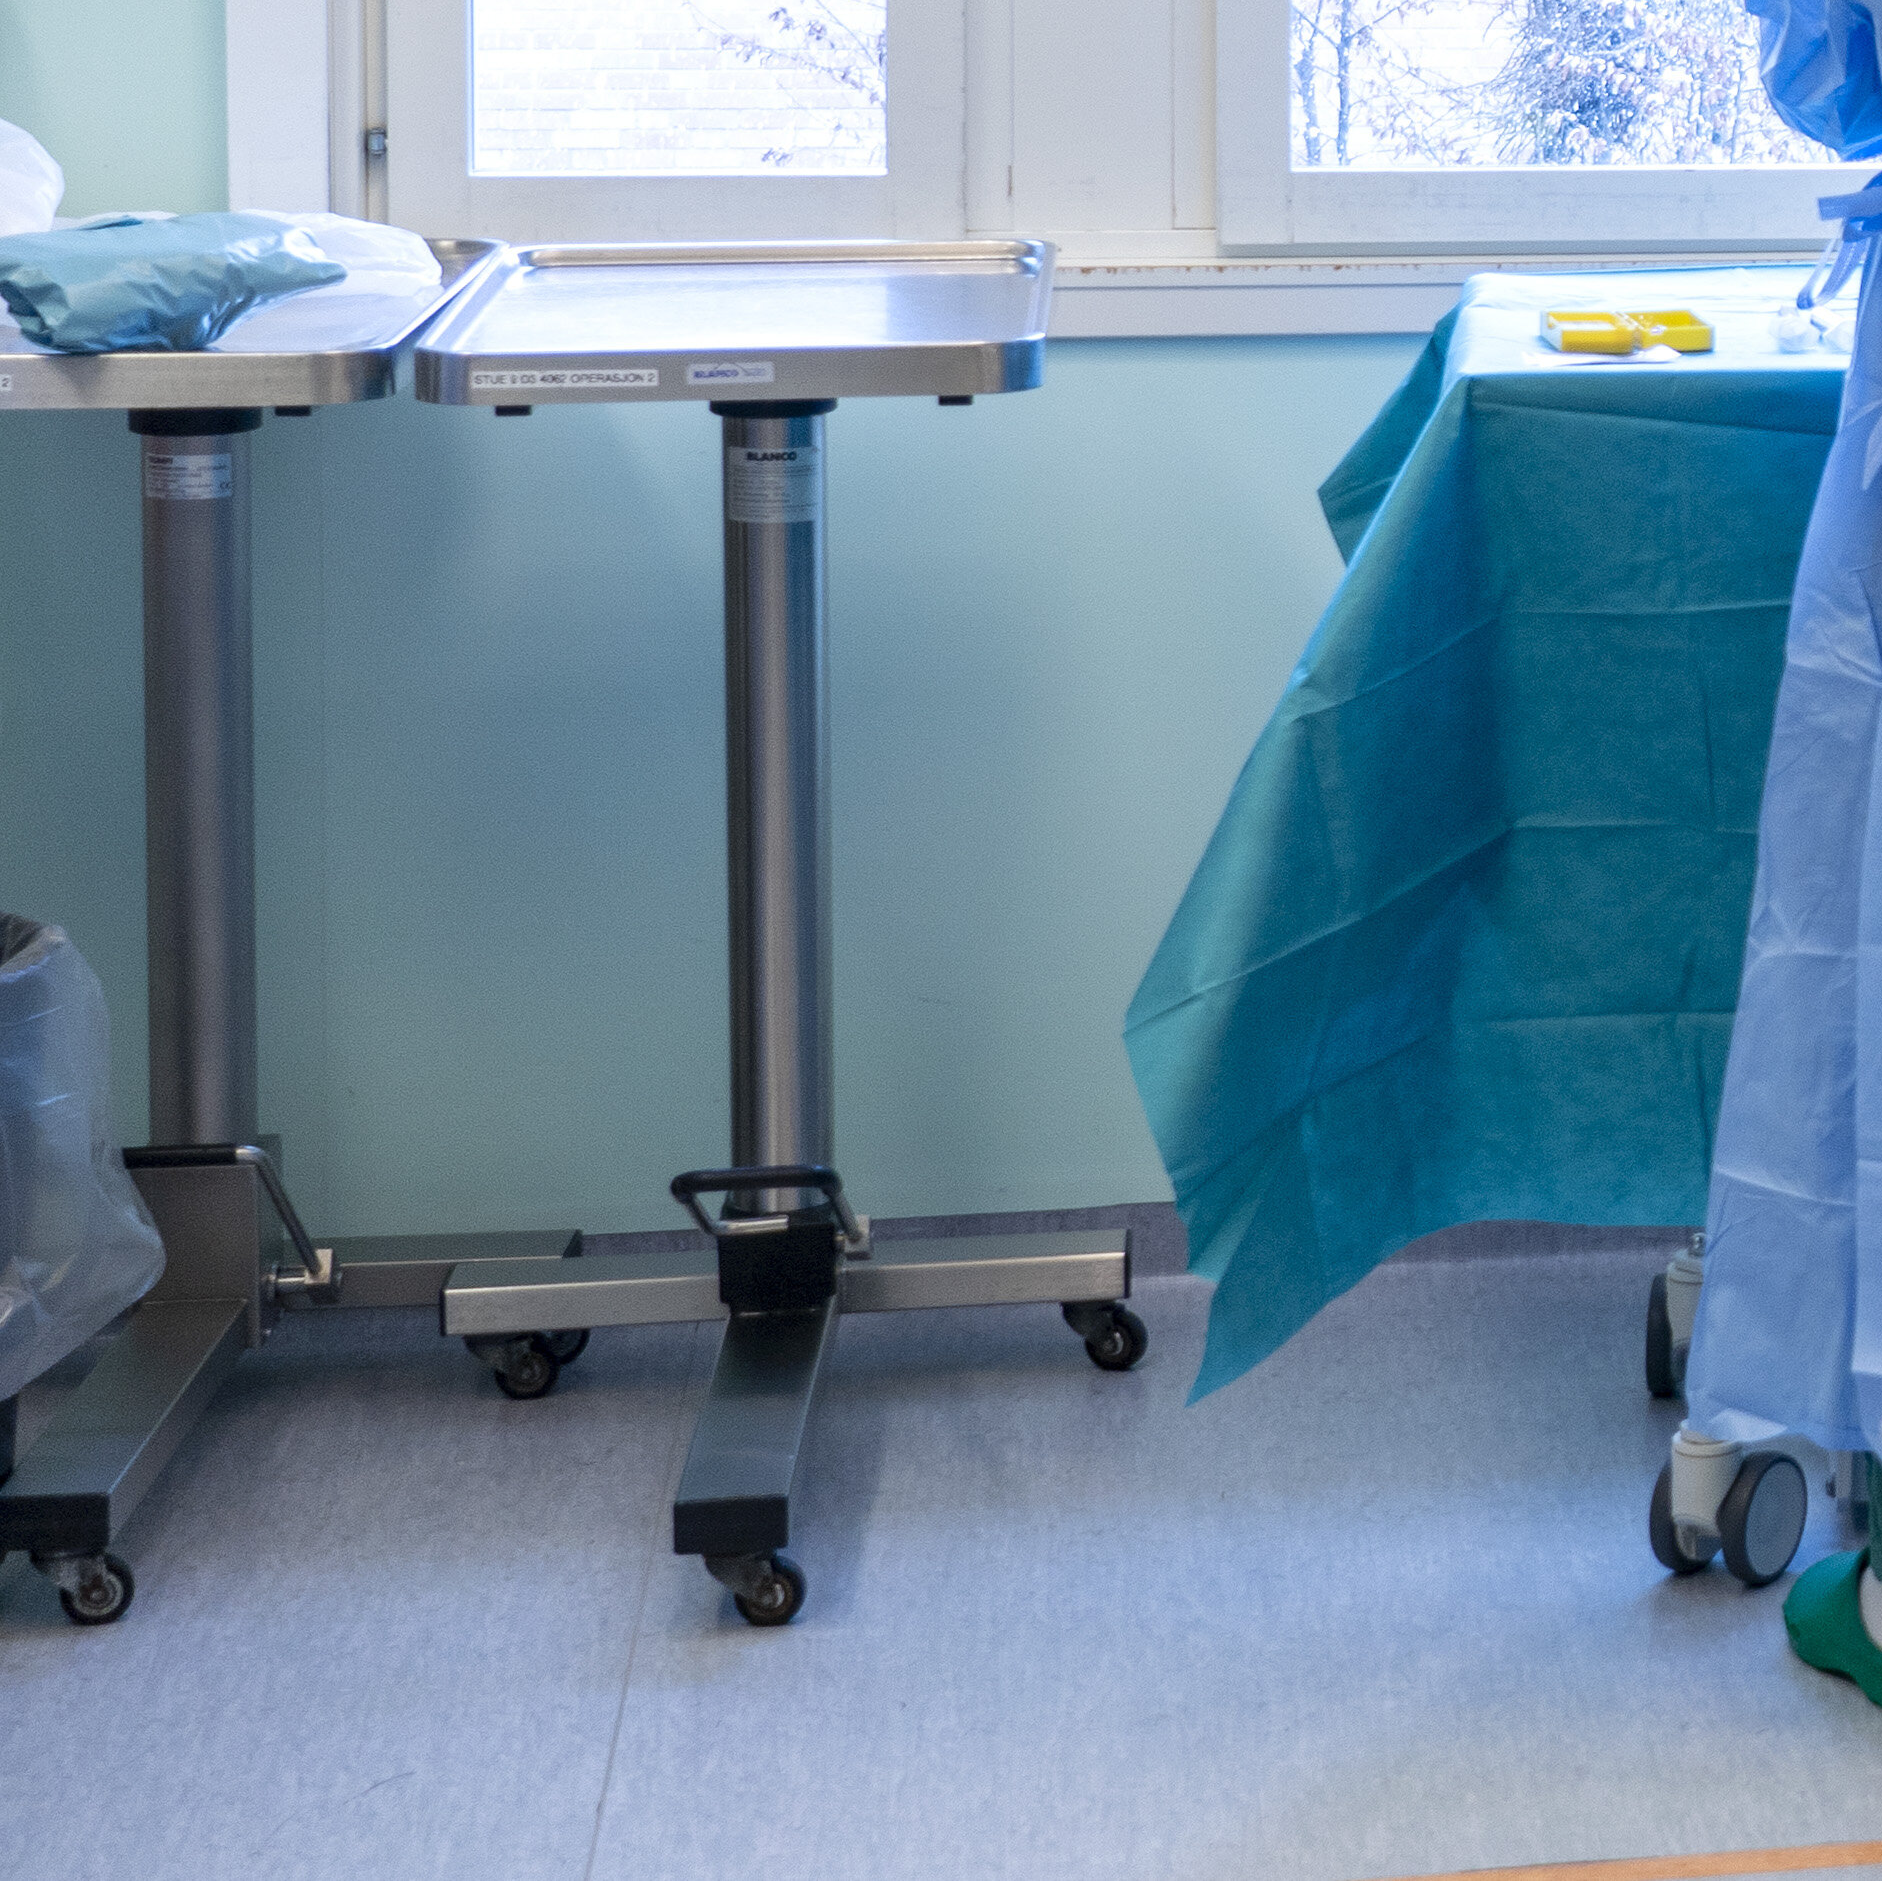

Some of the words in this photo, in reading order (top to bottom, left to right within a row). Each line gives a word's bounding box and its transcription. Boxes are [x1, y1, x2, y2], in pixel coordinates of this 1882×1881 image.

[474, 374, 506, 385] STUE
[570, 373, 643, 384] OPERASJON
[647, 372, 656, 383] 2
[746, 451, 798, 462] BLANCO
